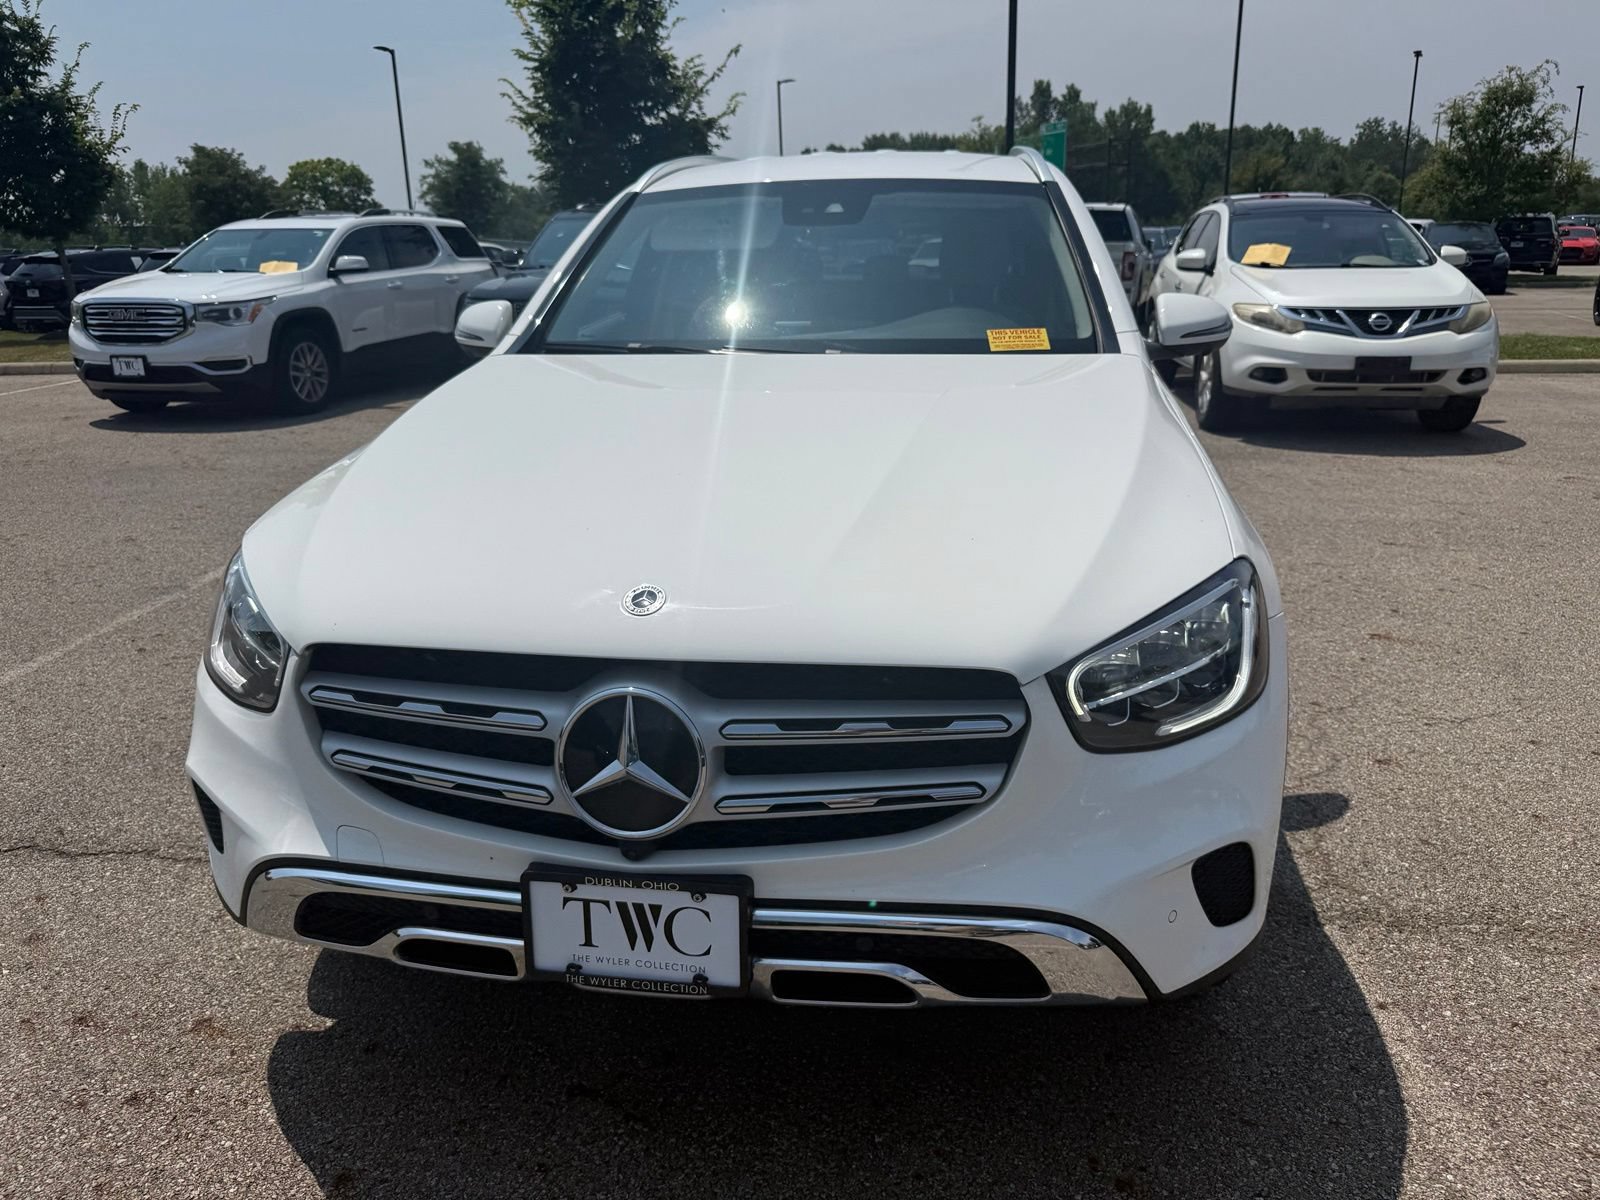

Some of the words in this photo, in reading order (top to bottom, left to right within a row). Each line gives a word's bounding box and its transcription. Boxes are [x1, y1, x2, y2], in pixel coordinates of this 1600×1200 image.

[107, 308, 147, 321] GMC
[641, 880, 680, 892] OHIO
[562, 896, 712, 957] TWC
[572, 953, 592, 964] THE
[595, 955, 630, 967] WYLER
[635, 958, 707, 975] COLLECTION
[565, 973, 585, 985] THE
[589, 976, 627, 989] WYLER
[631, 979, 708, 995] COLLECTION
